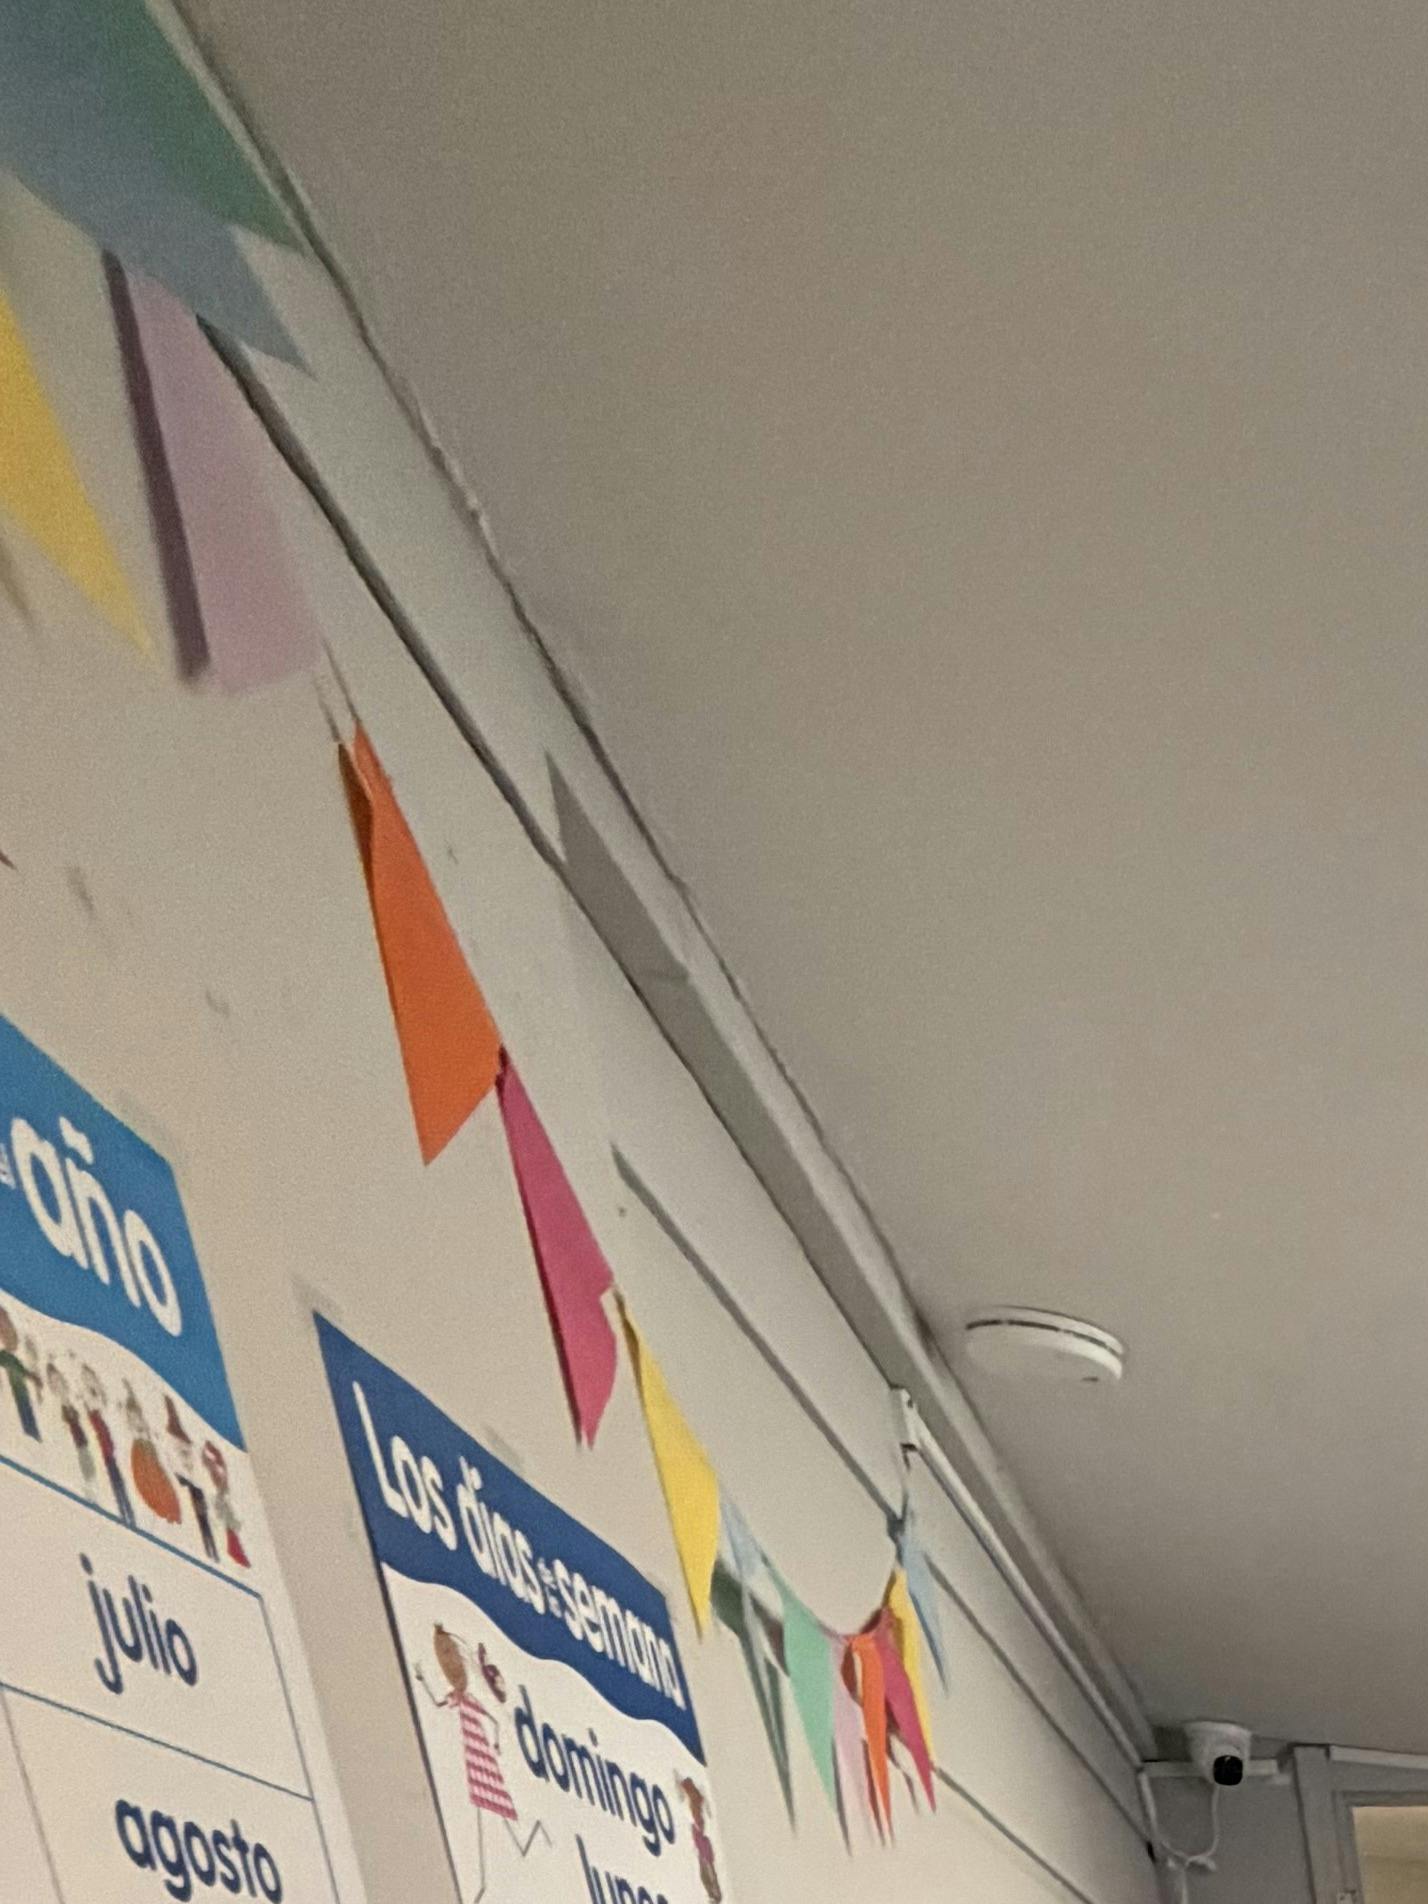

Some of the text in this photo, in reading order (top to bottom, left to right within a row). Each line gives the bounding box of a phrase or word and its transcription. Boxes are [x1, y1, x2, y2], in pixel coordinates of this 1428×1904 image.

[11, 1116, 182, 1337] año
[79, 1552, 197, 1694] julio
[352, 1380, 458, 1551] Los
[553, 1558, 686, 1711] semana
[115, 1798, 283, 1904] agosto
[514, 1684, 675, 1857] domingo
